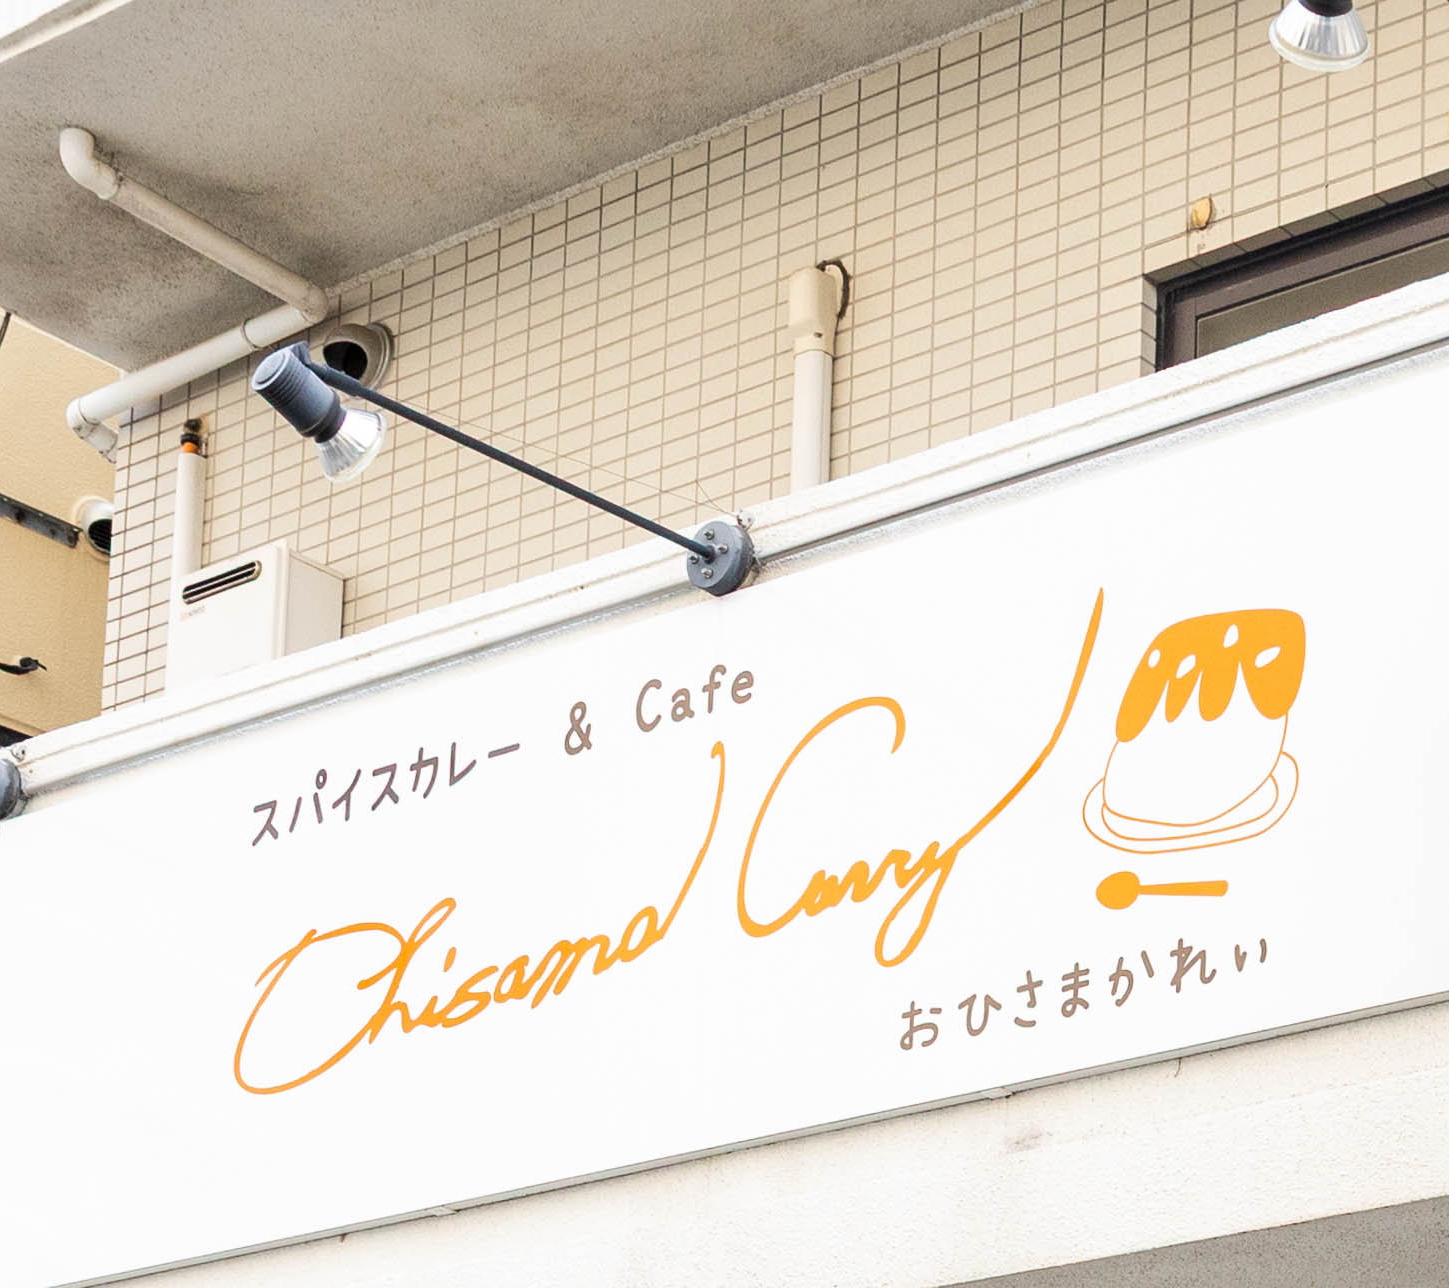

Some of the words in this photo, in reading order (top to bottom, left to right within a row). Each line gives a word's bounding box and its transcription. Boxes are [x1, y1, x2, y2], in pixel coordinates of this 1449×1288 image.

[249, 738, 520, 848] スパイスカレー
[563, 700, 592, 755] &
[634, 664, 755, 736] Cafe
[737, 587, 1104, 968] Curry
